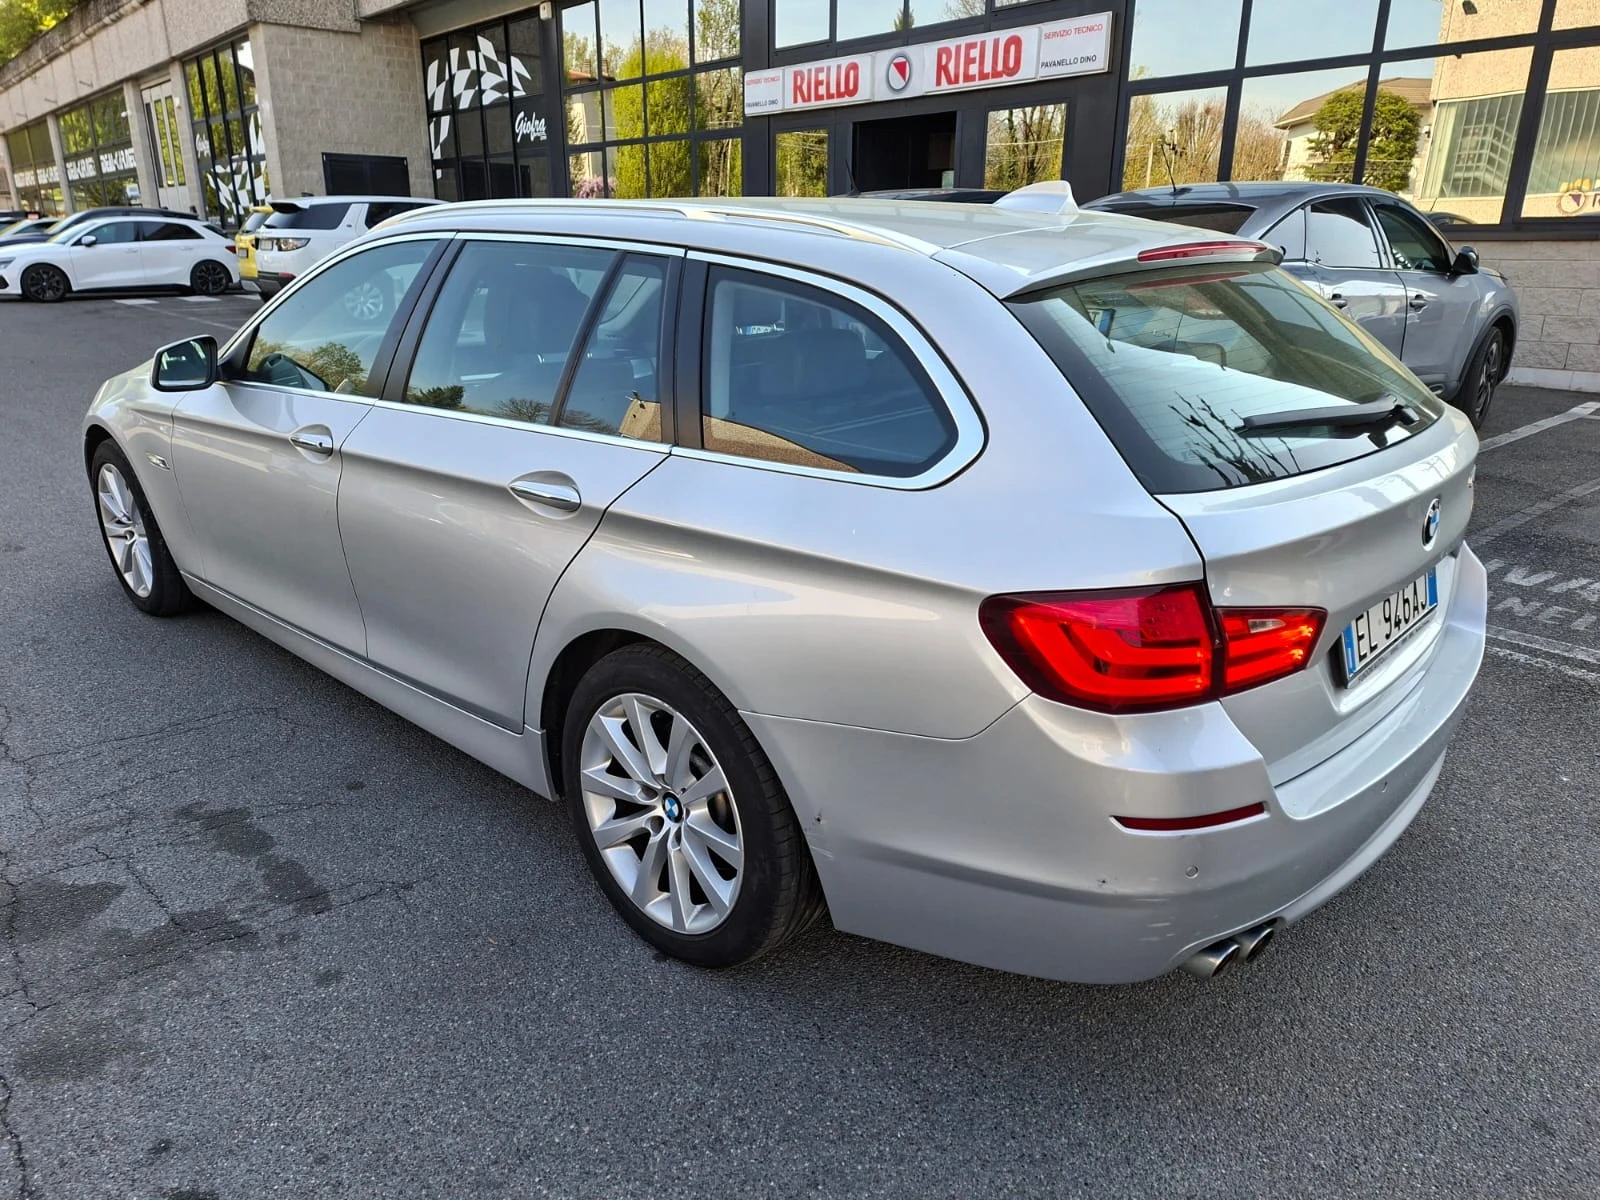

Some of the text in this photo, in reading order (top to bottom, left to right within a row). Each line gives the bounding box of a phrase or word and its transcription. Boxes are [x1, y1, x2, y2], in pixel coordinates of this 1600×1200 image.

[1044, 24, 1103, 40] SERVIZIO TECNICO
[936, 34, 1023, 87] RIELLO
[1041, 54, 1097, 69] PAVANELLO DINO
[792, 62, 859, 104] RIELLO
[1355, 609, 1378, 662] EL
